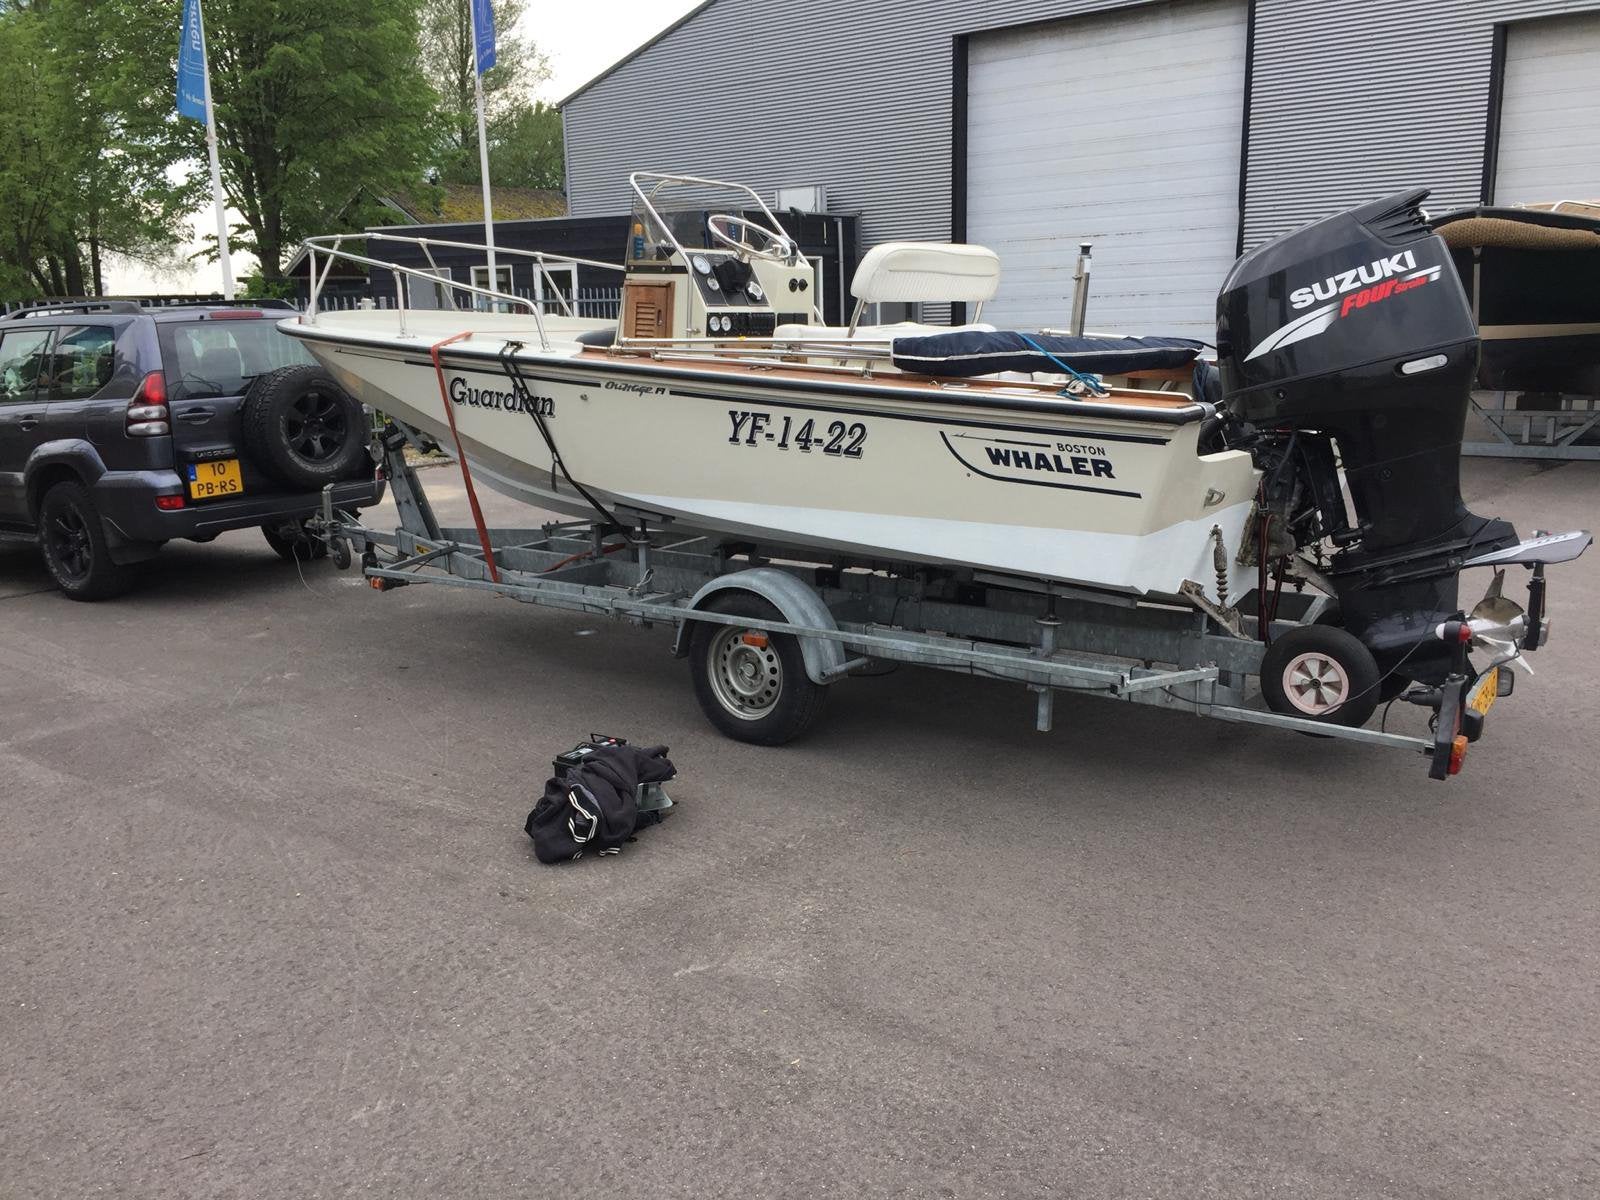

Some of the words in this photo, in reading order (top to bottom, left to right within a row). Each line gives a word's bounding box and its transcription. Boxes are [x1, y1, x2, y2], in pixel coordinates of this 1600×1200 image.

[1289, 250, 1417, 309] SUZUKI
[728, 410, 867, 459] YF-14-22
[1056, 442, 1106, 456] BOSTON
[211, 462, 226, 477] 10
[984, 446, 1116, 479] WHALER
[196, 478, 237, 496] PB-RS
